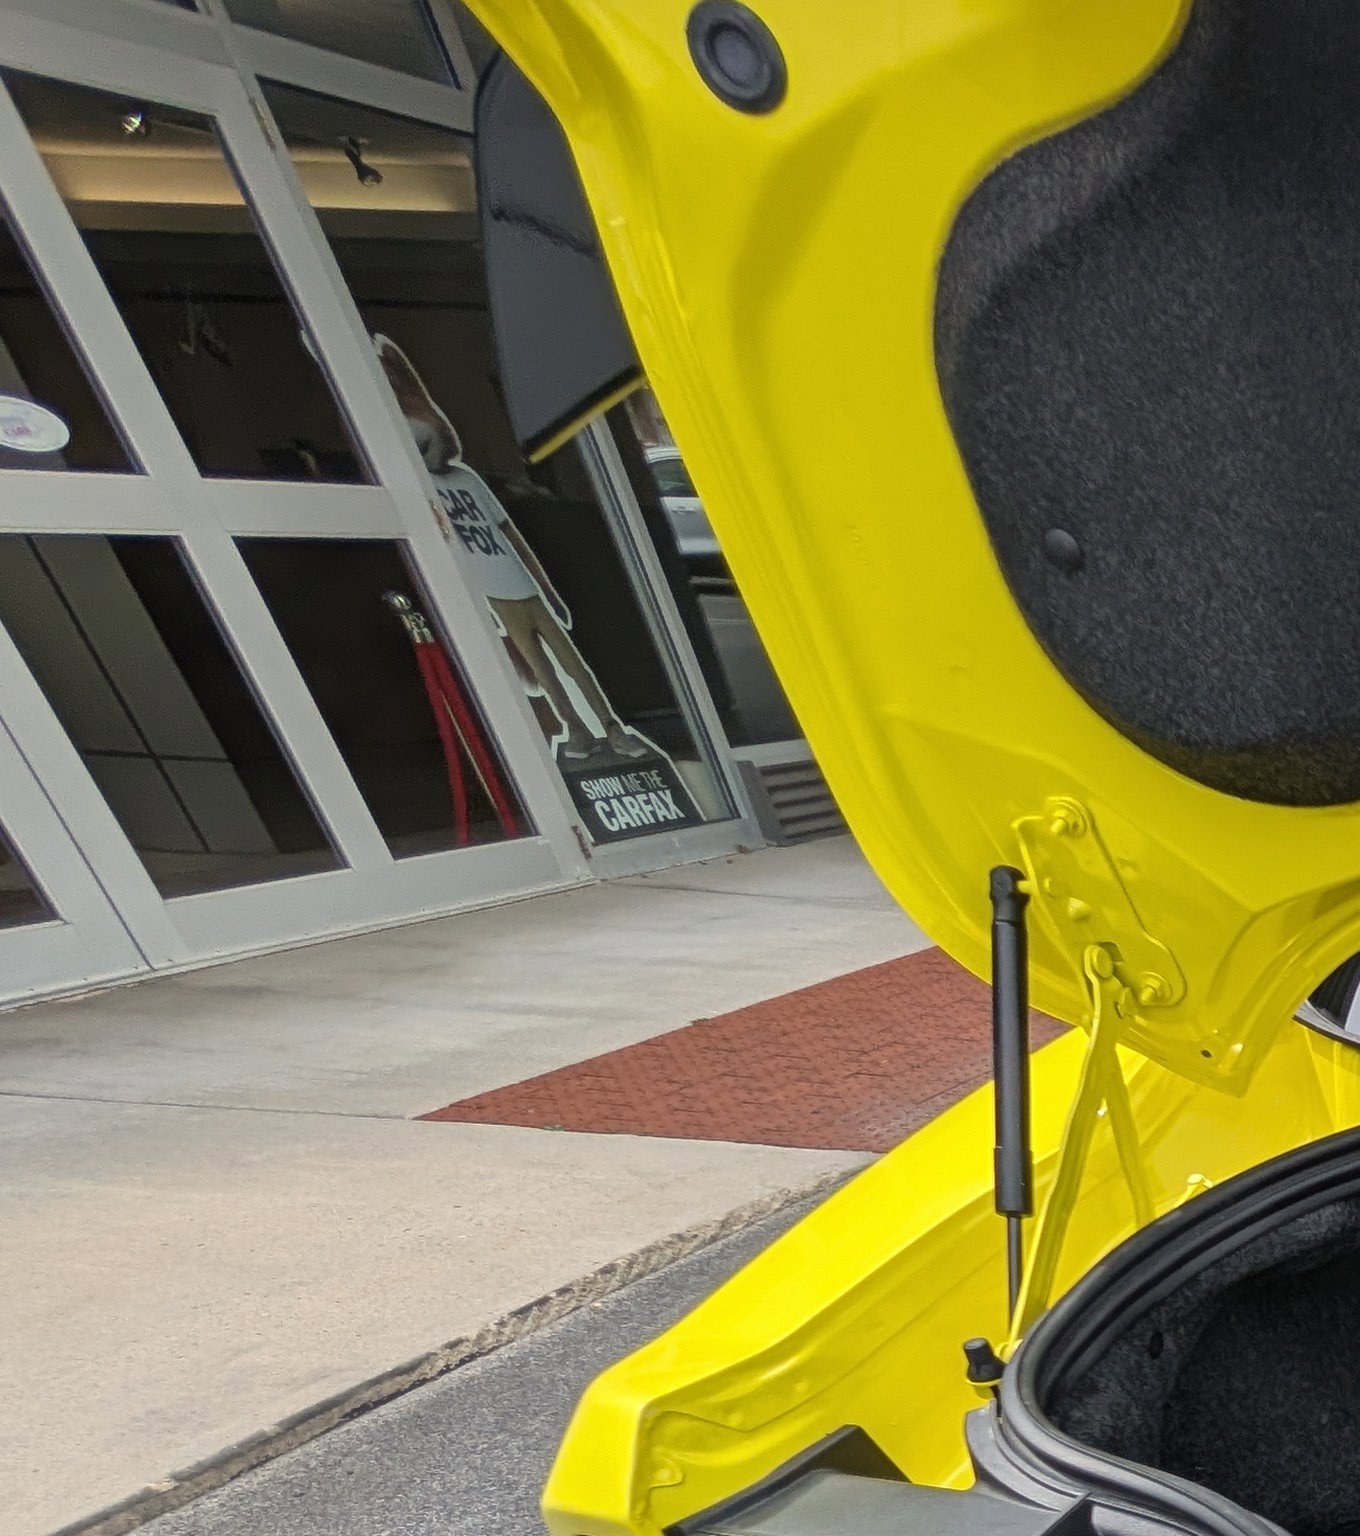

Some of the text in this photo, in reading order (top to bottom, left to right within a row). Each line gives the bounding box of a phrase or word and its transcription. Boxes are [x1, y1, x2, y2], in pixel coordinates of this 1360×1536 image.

[452, 522, 507, 556] FOX
[580, 769, 668, 800] SHOW ME THE
[594, 789, 686, 832] CARFAX
